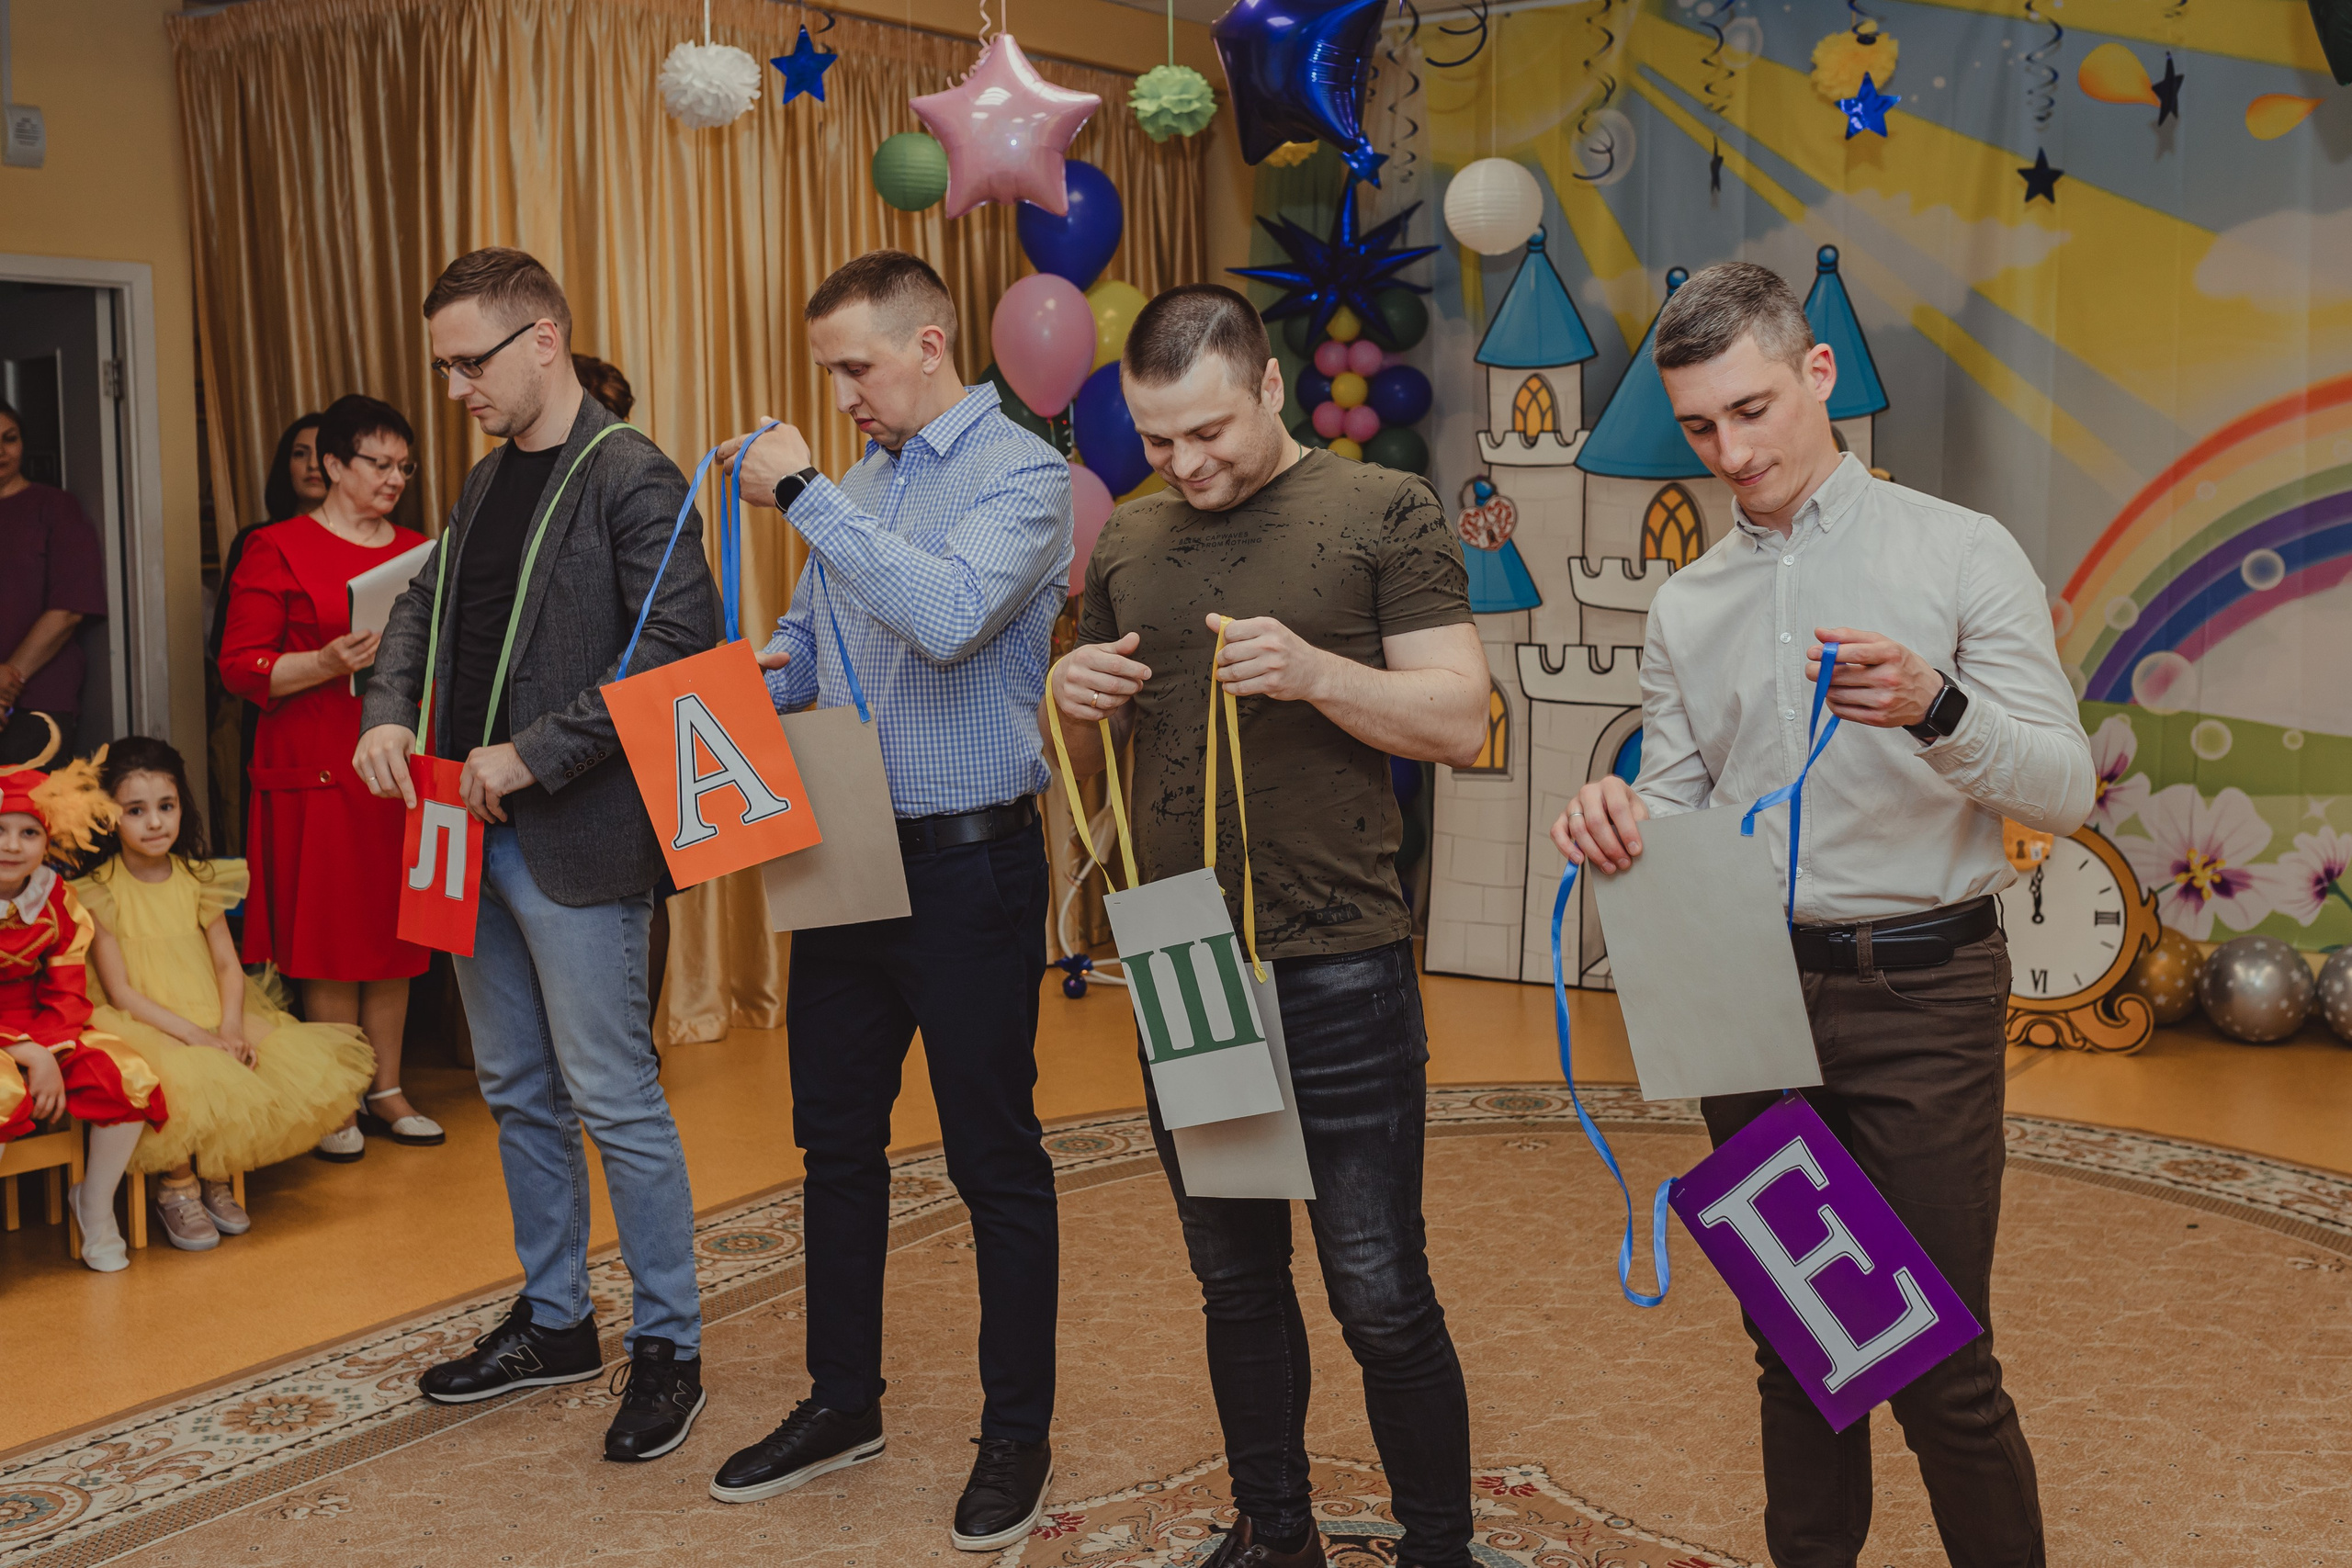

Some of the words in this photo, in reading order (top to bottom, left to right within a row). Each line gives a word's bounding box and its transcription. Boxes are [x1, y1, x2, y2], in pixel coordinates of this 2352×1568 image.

[1205, 532, 1249, 541] CAPWAVES
[1226, 537, 1262, 547] NOTHING
[671, 692, 791, 852] А
[408, 798, 468, 901] Л
[1120, 931, 1266, 1065] Ш
[2030, 968, 2048, 994] VI
[1697, 1134, 1939, 1394] Е
[496, 1344, 544, 1380] N
